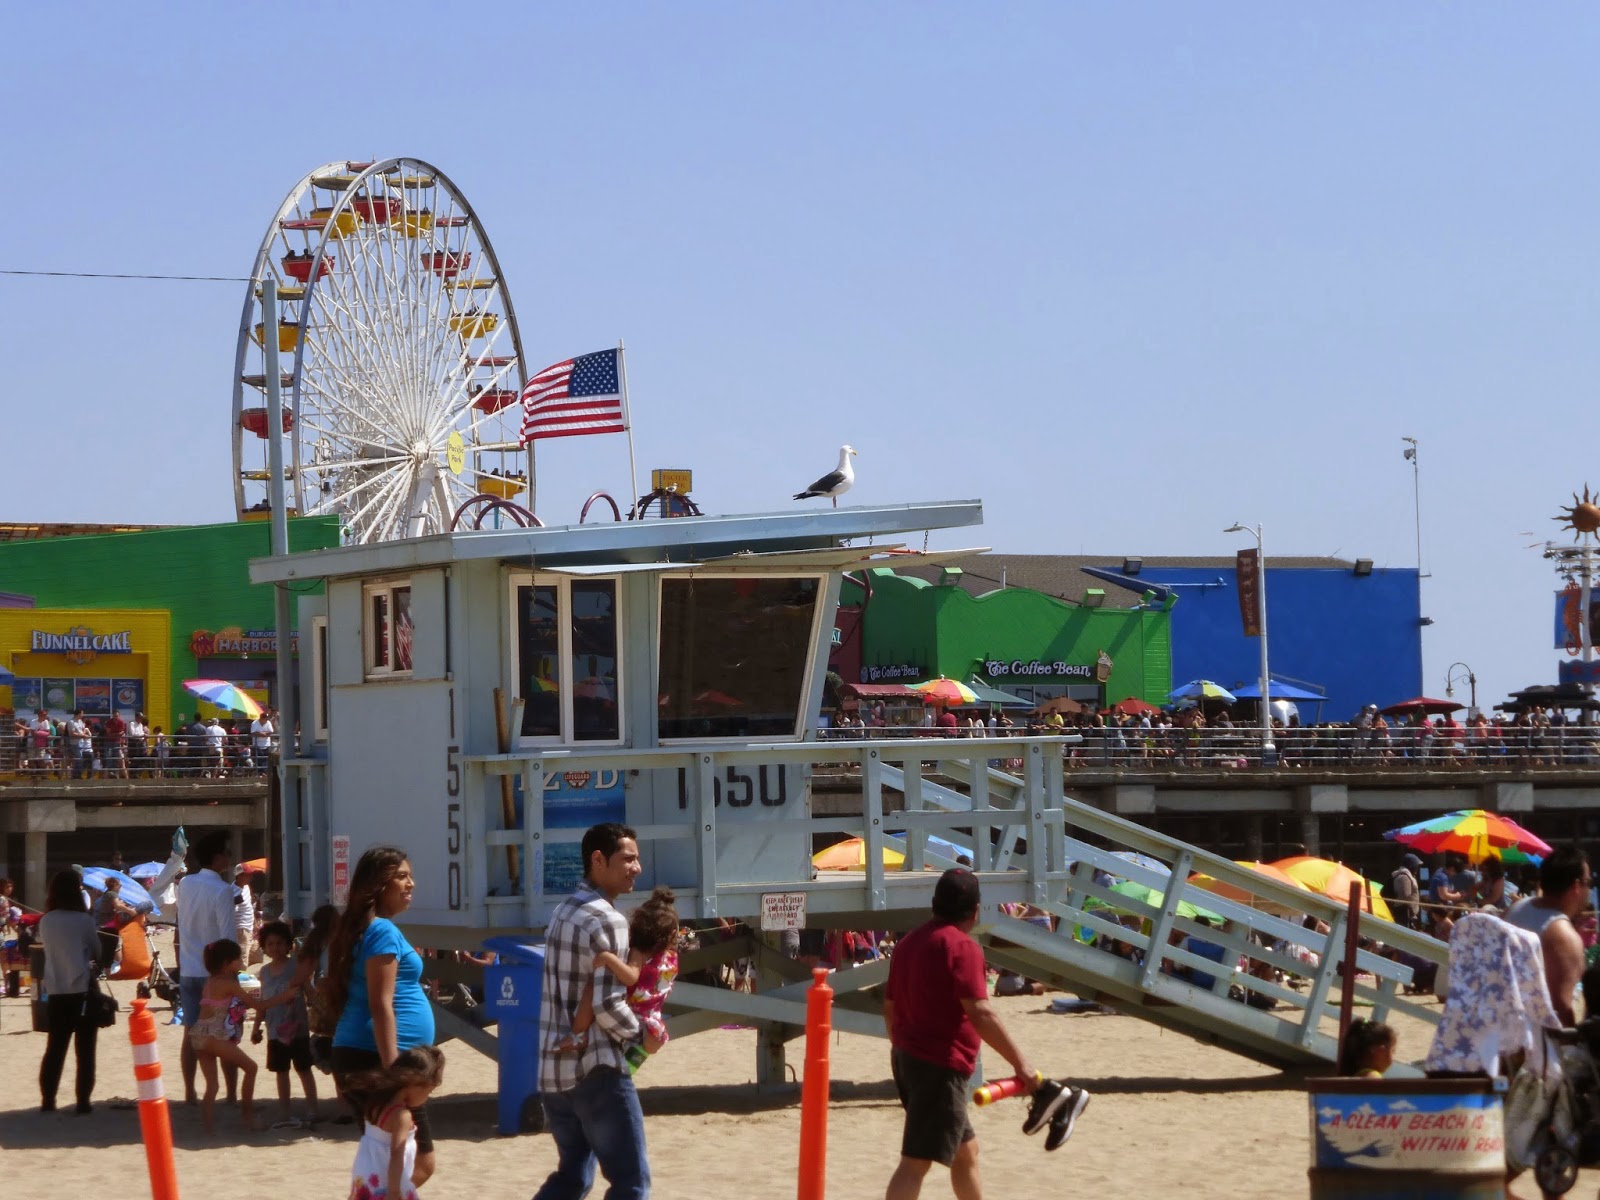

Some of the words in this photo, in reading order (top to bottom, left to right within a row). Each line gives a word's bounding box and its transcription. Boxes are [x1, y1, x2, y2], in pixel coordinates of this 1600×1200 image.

[32, 630, 92, 650] FUNNEL
[92, 631, 131, 650] CAKE
[219, 639, 277, 652] HARBOR
[869, 667, 880, 680] The
[881, 665, 901, 678] Coffee
[901, 664, 920, 677] Bean
[986, 660, 1009, 677] The
[1011, 660, 1052, 675] Coffee
[1052, 661, 1091, 677] Bean
[564, 772, 590, 780] LIFEGUARD
[678, 764, 787, 809] 150
[1331, 1114, 1342, 1126] A
[1346, 1113, 1403, 1129] CLEAN
[1408, 1114, 1468, 1130] BEACH
[1472, 1114, 1484, 1130] IS
[1401, 1136, 1470, 1151] WITHIN
